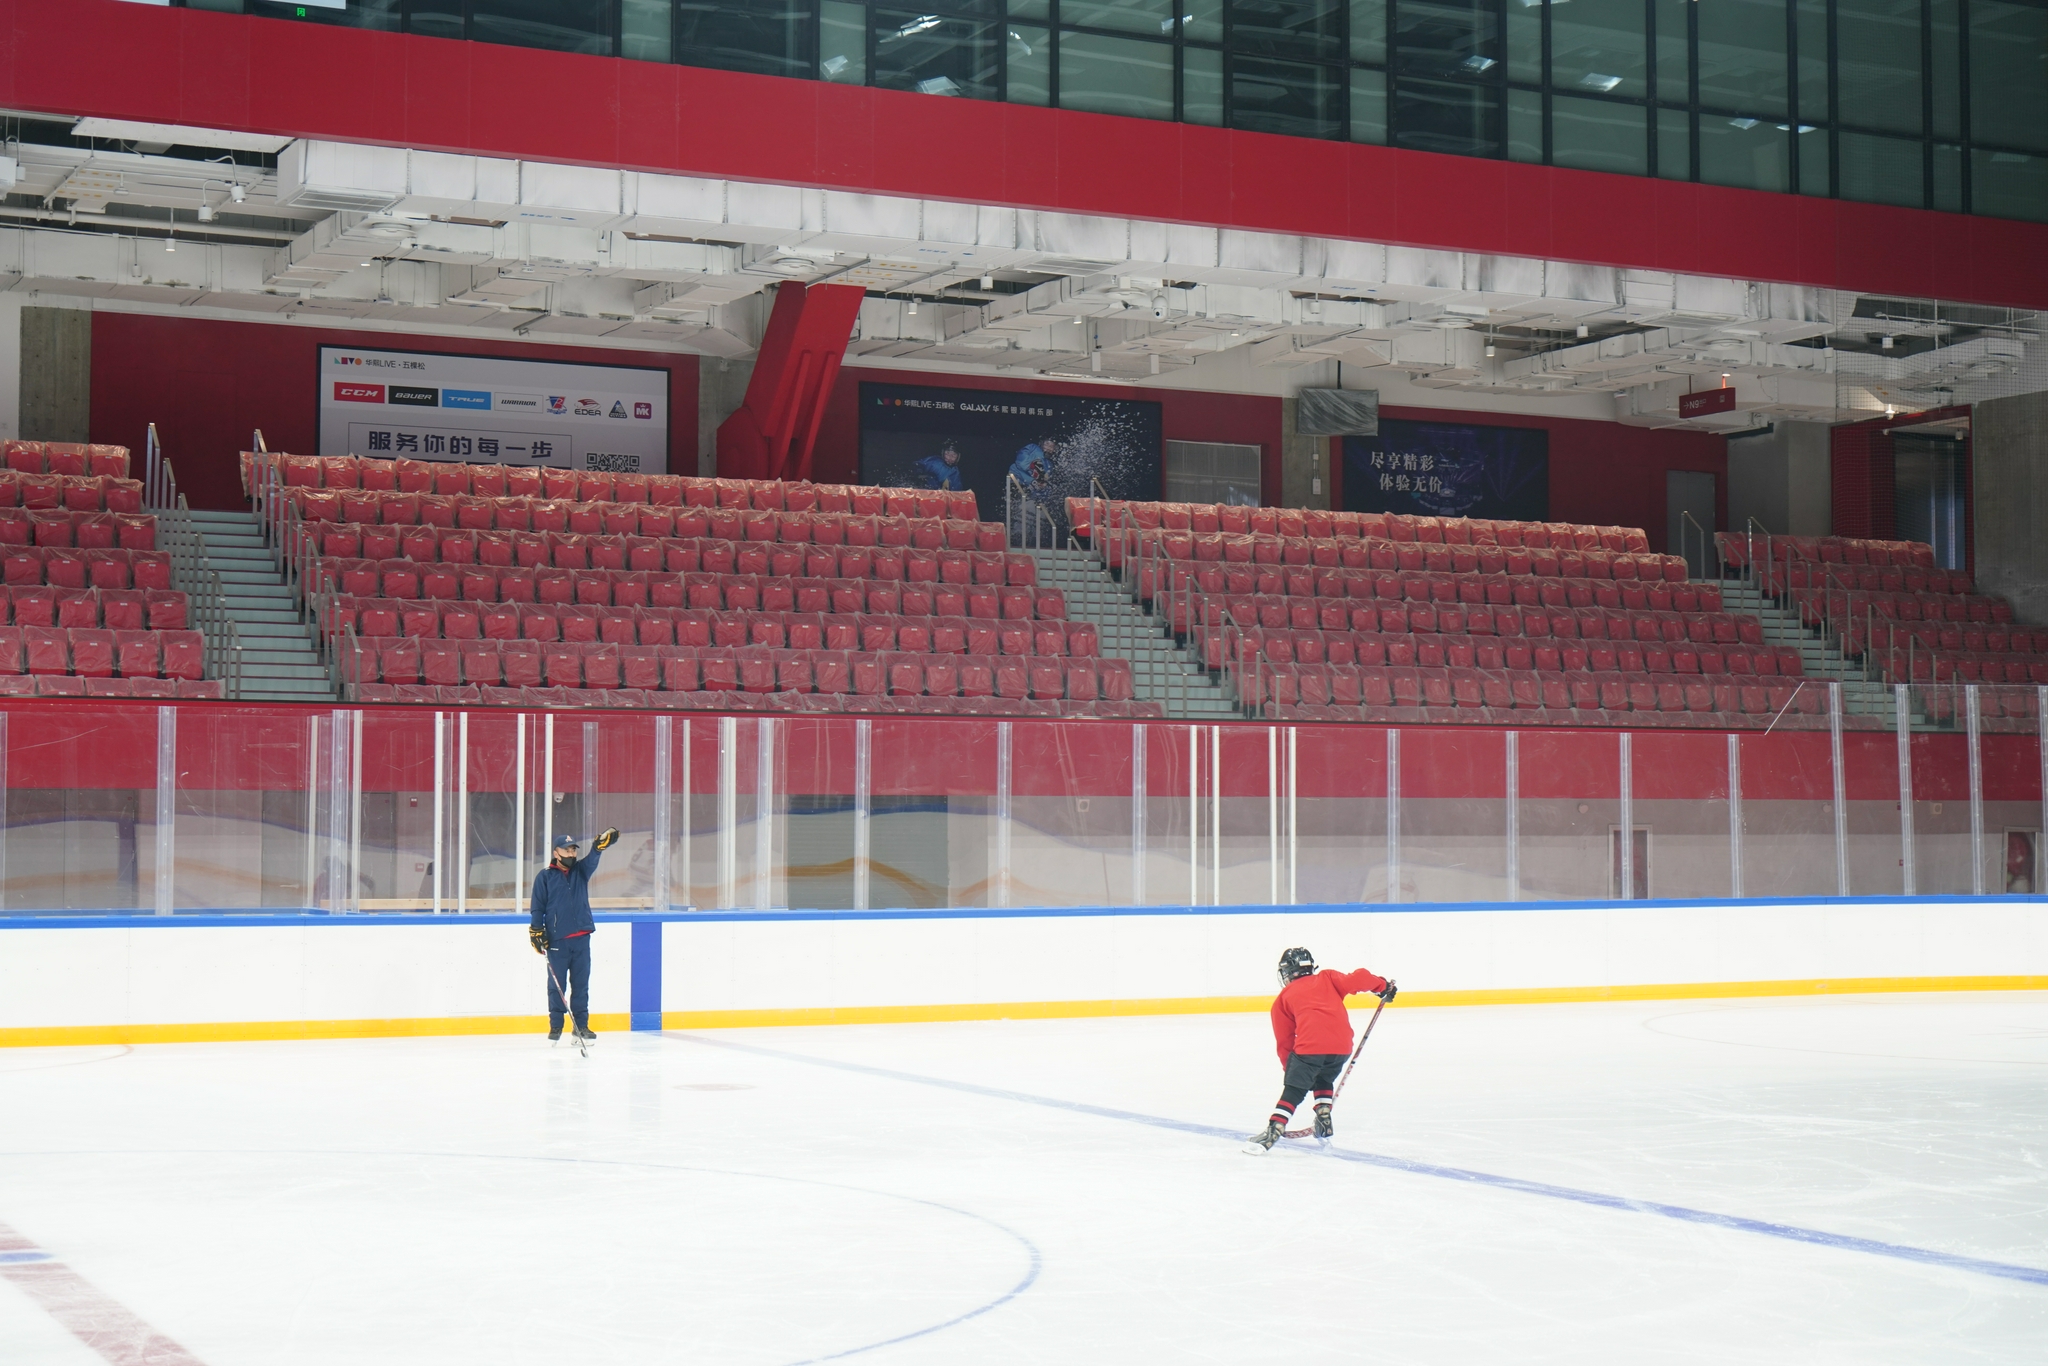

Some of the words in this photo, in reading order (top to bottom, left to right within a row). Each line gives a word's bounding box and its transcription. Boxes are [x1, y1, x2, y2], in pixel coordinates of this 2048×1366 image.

[341, 388, 378, 397] CCM
[574, 408, 602, 417] EDEA
[636, 407, 650, 416] MK
[960, 402, 991, 413] GALAXY
[368, 430, 553, 459] 服务你的每一步
[1370, 451, 1435, 472] 尽享精彩
[1379, 472, 1442, 494] 体验无价
